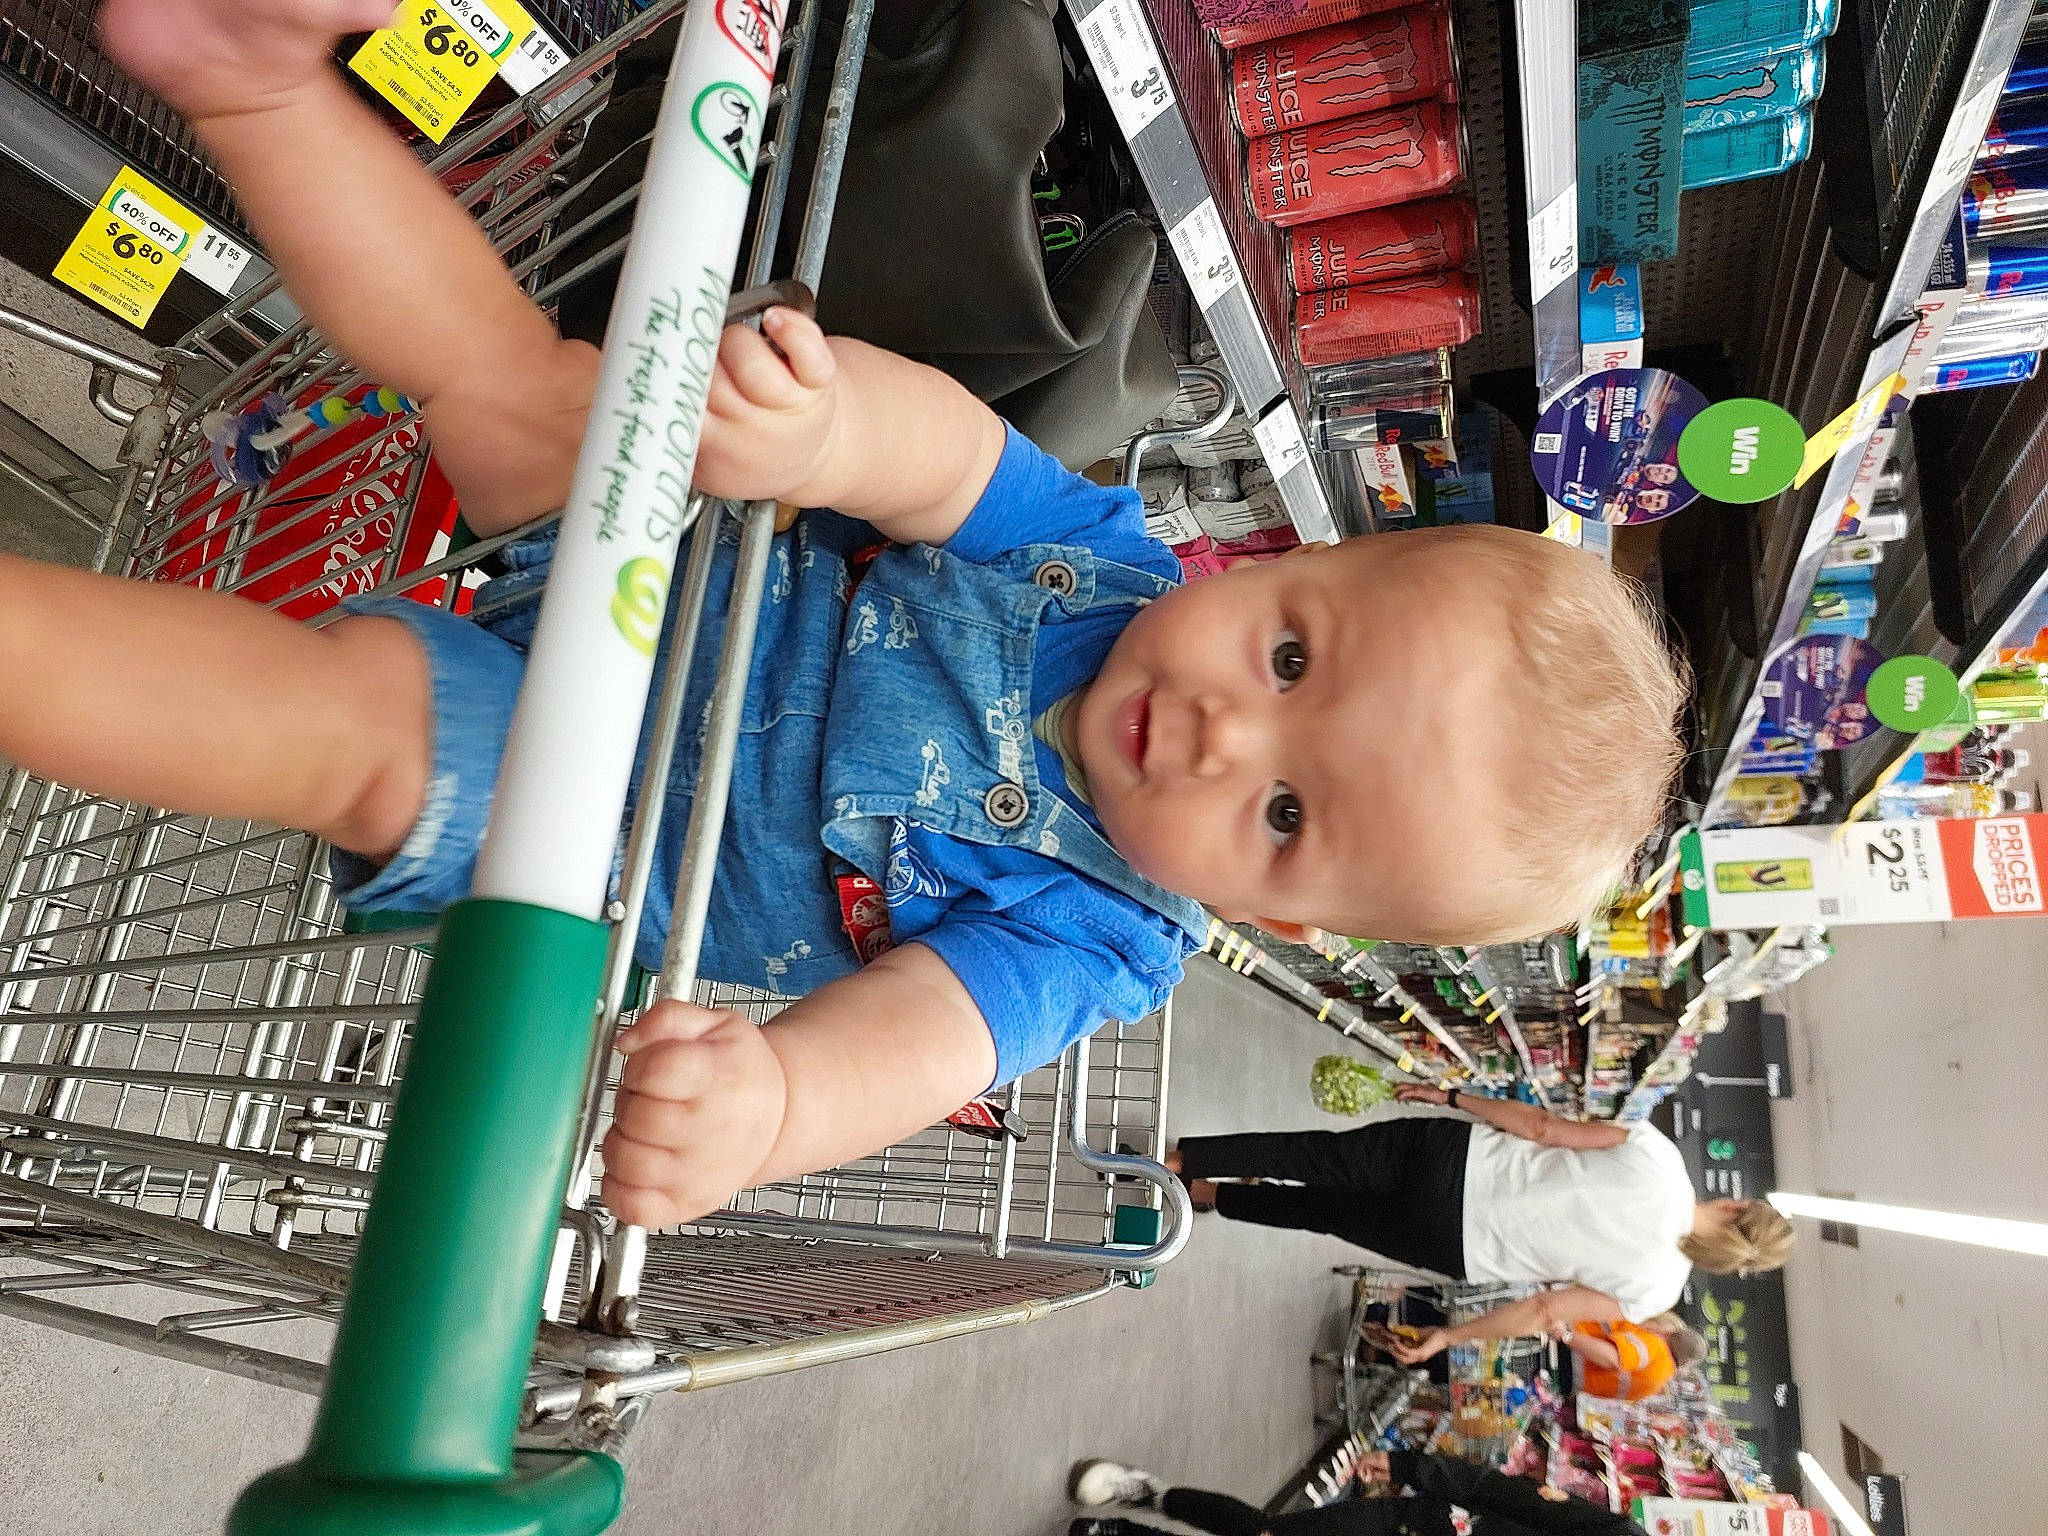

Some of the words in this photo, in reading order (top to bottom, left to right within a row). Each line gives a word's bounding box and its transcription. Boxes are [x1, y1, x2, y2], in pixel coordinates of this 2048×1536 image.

[471, 14, 500, 42] OFF
[383, 41, 401, 57] Mother
[398, 55, 416, 72] Energy
[414, 68, 428, 82] Drink
[430, 65, 449, 83] SAVE
[446, 80, 464, 97] $4.75
[1251, 48, 1278, 133] MONSTER
[1274, 48, 1304, 126] JUICE
[1632, 125, 1666, 238] MONSTER
[120, 202, 148, 226] 40%
[150, 222, 178, 245] OFF
[123, 266, 141, 280] SAVE
[645, 288, 682, 336] The
[625, 343, 669, 405] fresh
[612, 411, 653, 471] food
[1729, 426, 1760, 475] Win
[591, 465, 628, 544] people
[1903, 674, 1926, 713] Win
[1983, 825, 2011, 906] DROPPED
[2000, 824, 2034, 905] PRICES
[1866, 1476, 1883, 1523] Lollies
